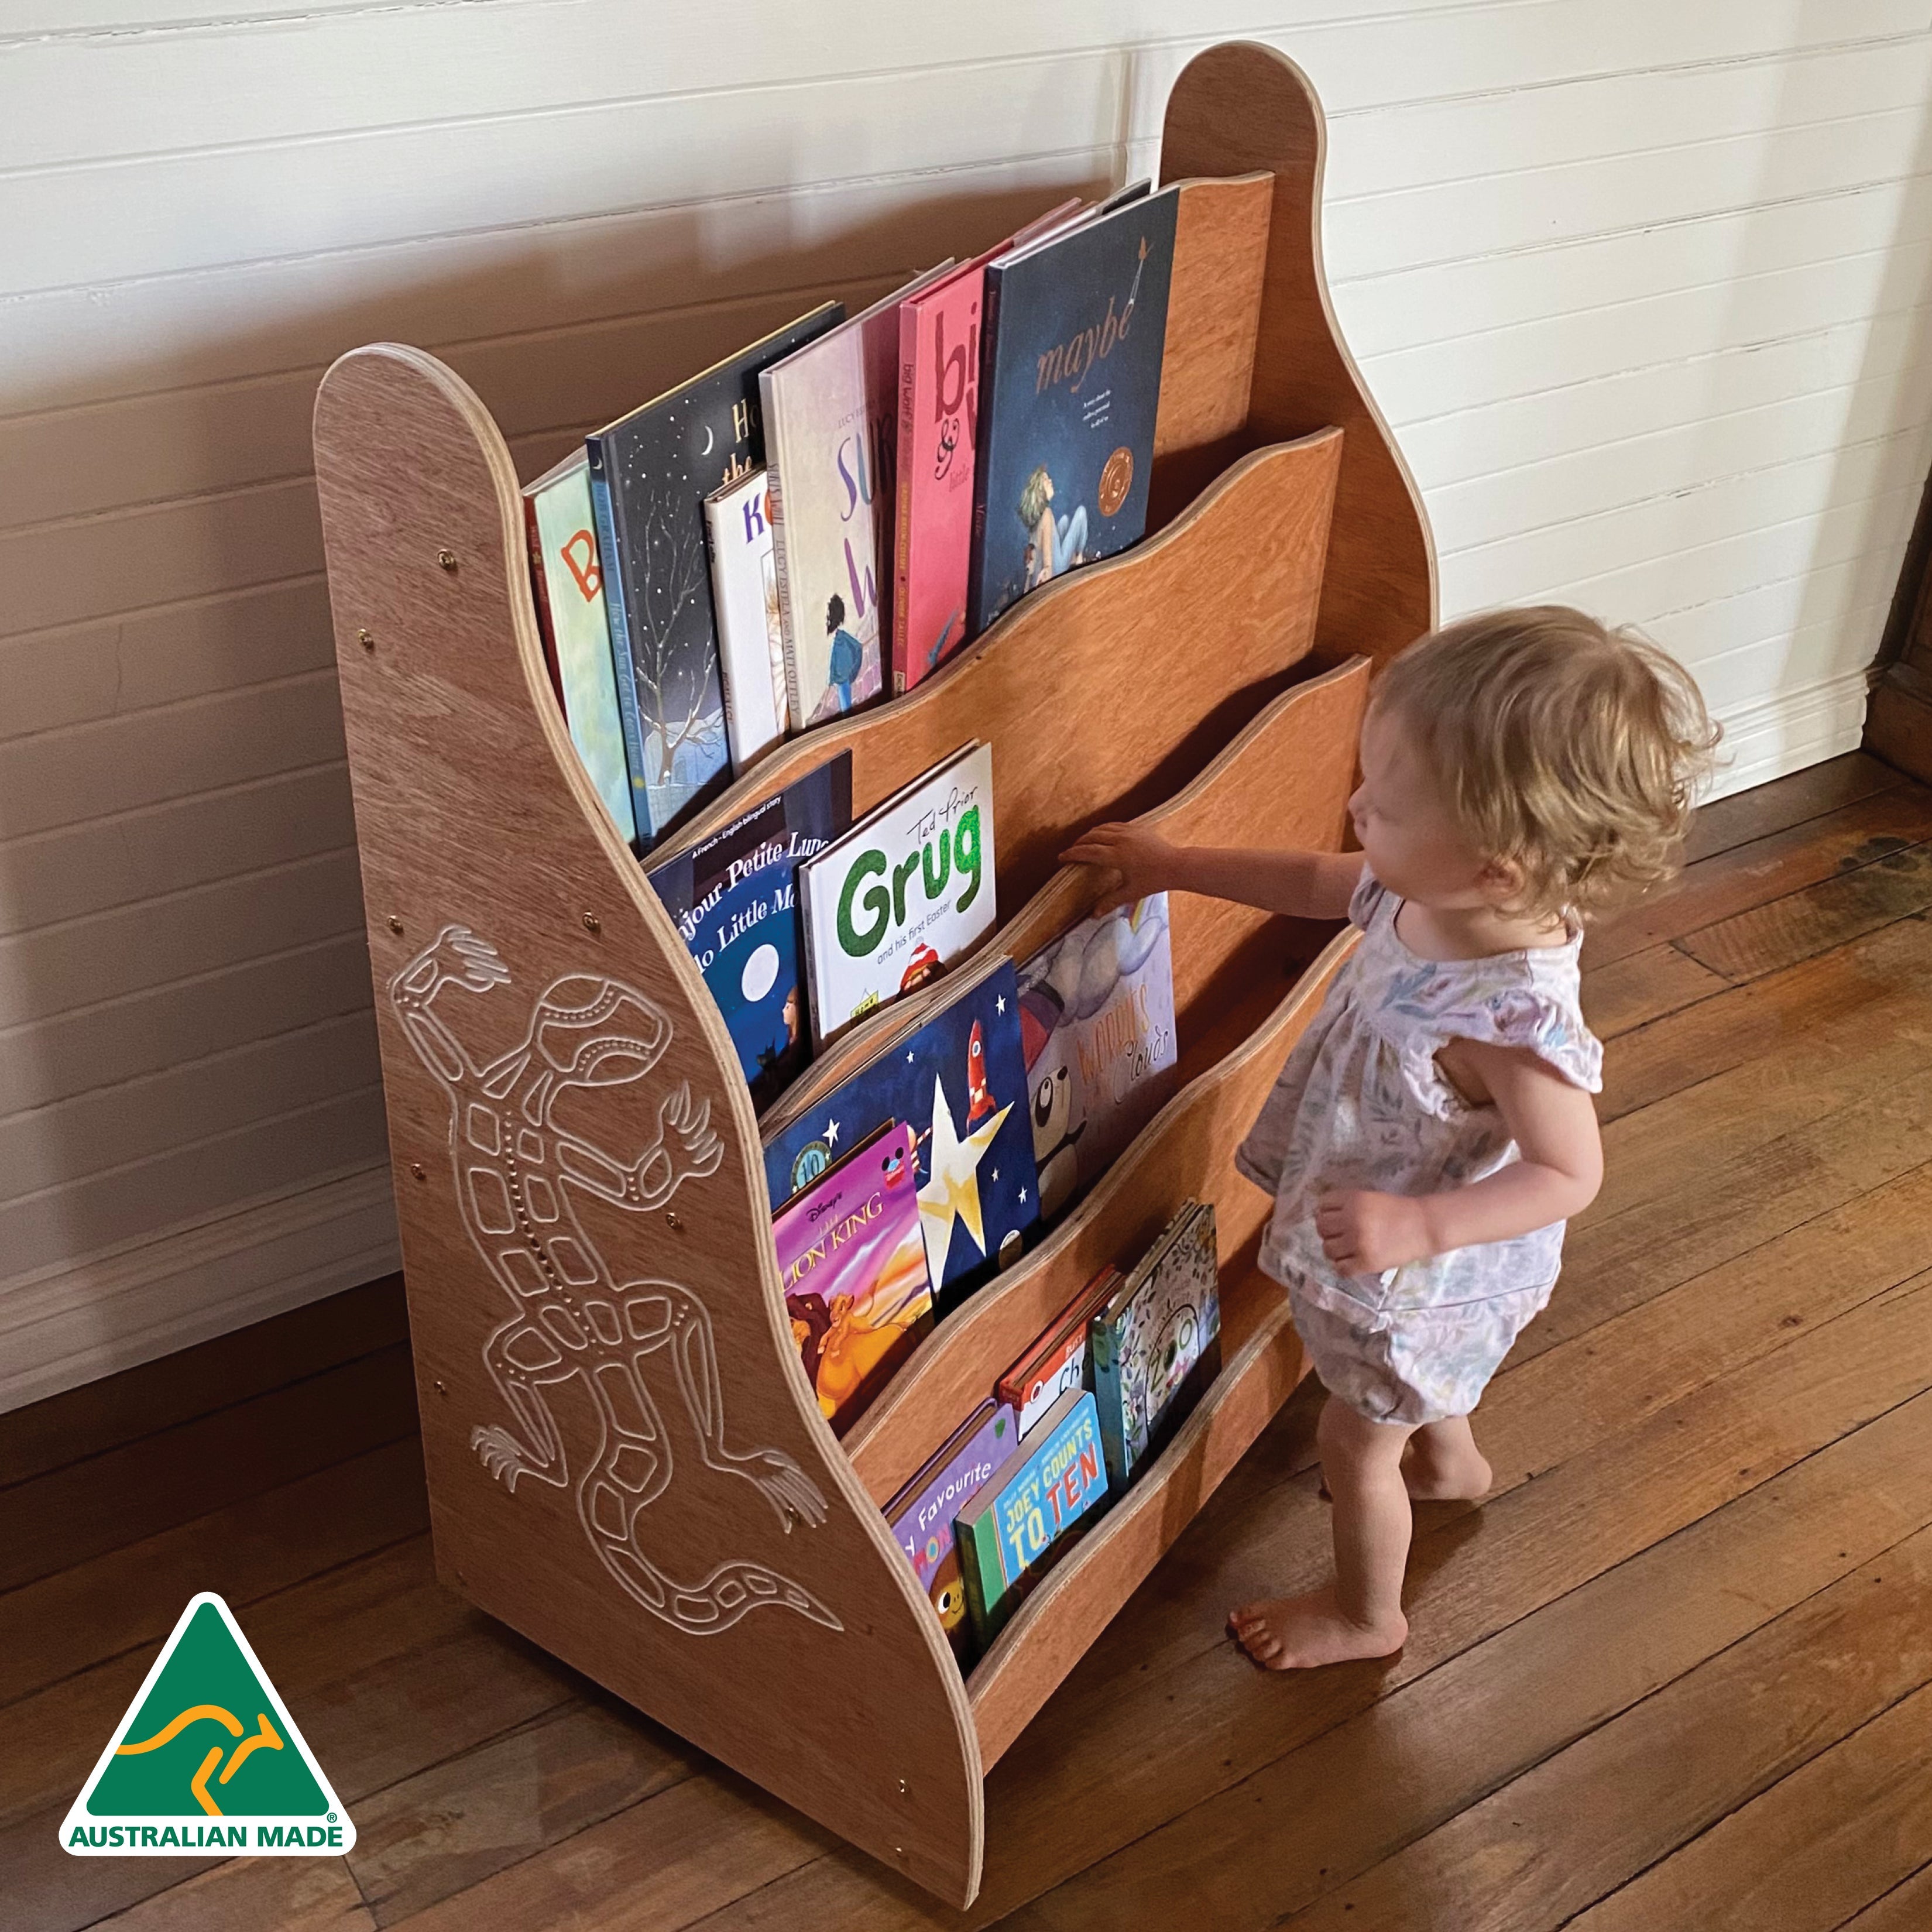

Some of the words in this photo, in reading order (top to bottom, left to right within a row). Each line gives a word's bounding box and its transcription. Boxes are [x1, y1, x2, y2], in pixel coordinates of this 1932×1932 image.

[1037, 295, 1134, 394] maybe
[775, 540, 787, 575] LUCY
[692, 850, 698, 859] A
[698, 837, 718, 856] French
[722, 821, 743, 839] English
[743, 804, 766, 825] bilingual
[767, 795, 782, 810] story
[907, 808, 936, 845] Ted
[938, 787, 979, 822] Prior
[726, 841, 783, 892] Petite
[836, 804, 982, 958] Grug
[717, 900, 767, 952] Little
[877, 943, 894, 965] and
[895, 935, 907, 951] his
[908, 920, 926, 941] first
[926, 899, 952, 926] Easter
[779, 1239, 826, 1292] LION
[831, 1192, 884, 1251] KING
[918, 1462, 991, 1532] Favourite
[1006, 1476, 1039, 1533] JOEY
[1042, 1418, 1093, 1488] COUNTS
[1009, 1507, 1045, 1570] TO
[1046, 1442, 1099, 1525] TEN
